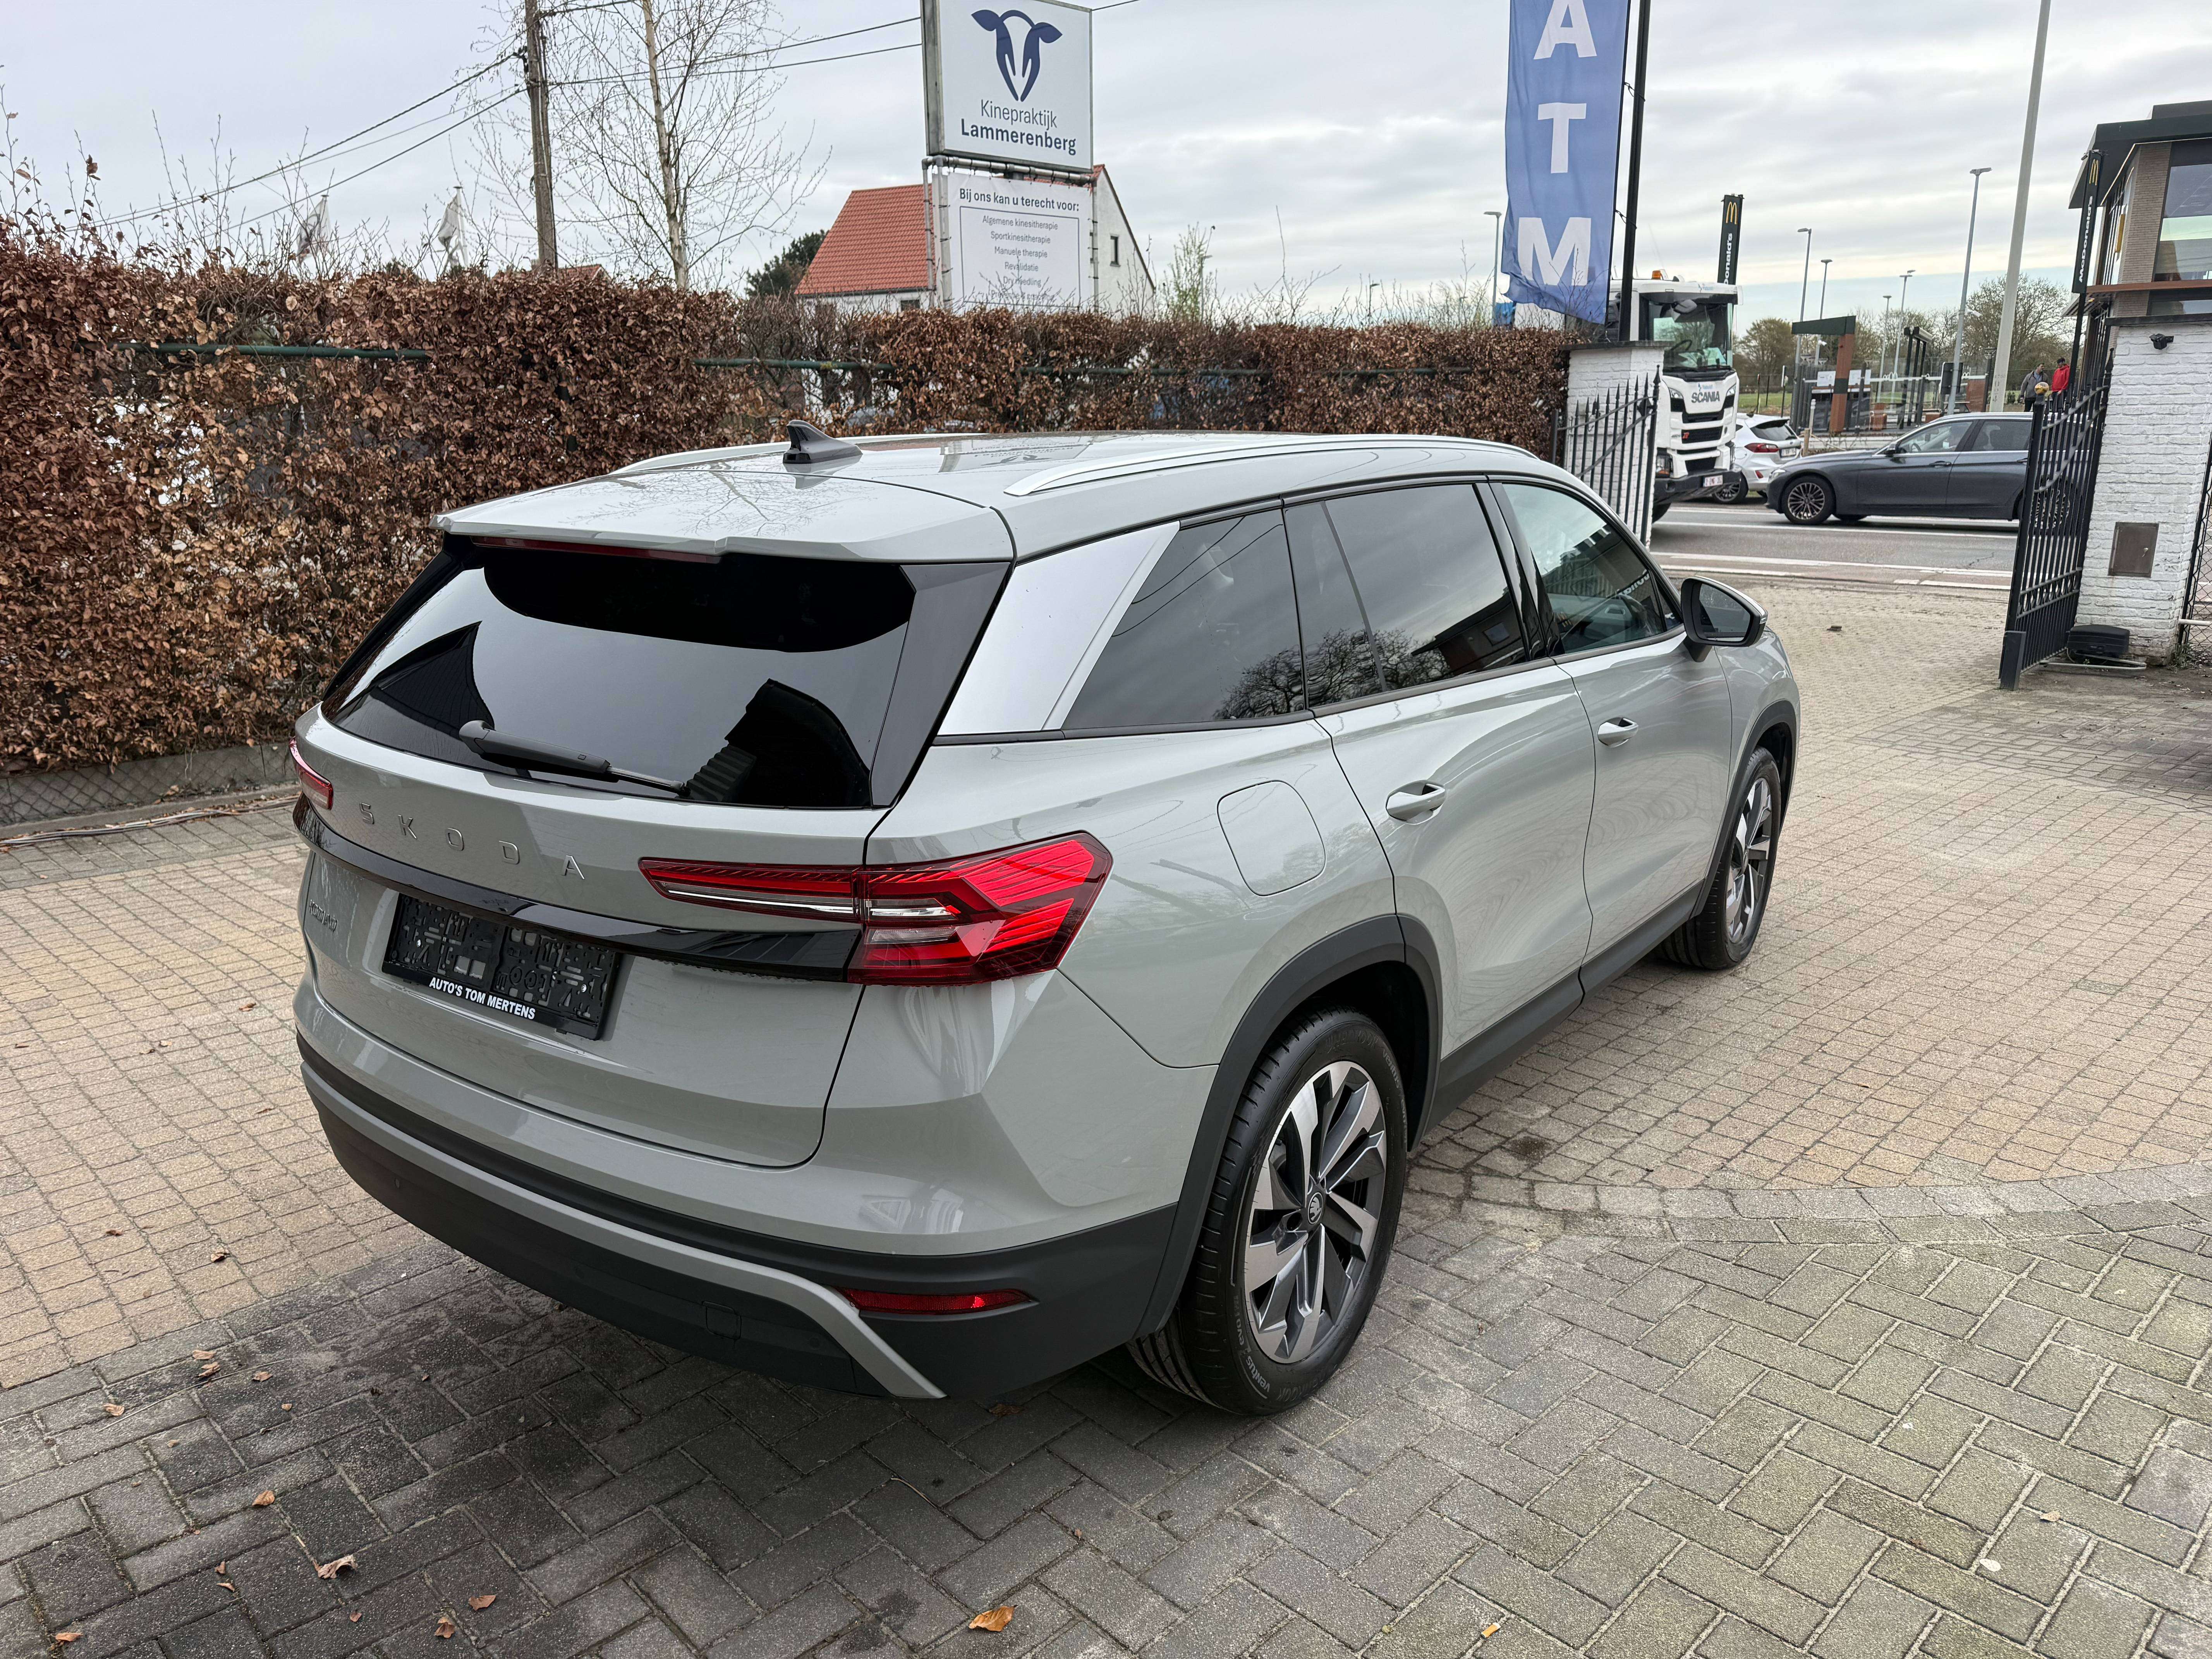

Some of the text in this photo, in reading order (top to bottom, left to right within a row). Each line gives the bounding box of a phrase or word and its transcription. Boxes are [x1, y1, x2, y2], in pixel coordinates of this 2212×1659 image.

[981, 99, 1057, 131] Kinepraktijk
[961, 118, 1076, 155] Lammerenberg
[960, 188, 1079, 211] Bij ons kan u terecht voor:
[982, 215, 1058, 231] Algemene kinesitherapie
[991, 231, 1051, 245] Sportkinesitherapie
[994, 246, 1048, 259] Manuele therapie
[1005, 262, 1039, 272] Revalidatie
[1003, 276, 1042, 288] Dry needling
[1691, 391, 1720, 403] SCANIA
[429, 977, 536, 1020] AUTO'S TOM MERTENS
[1245, 1355, 1271, 1393] ventus
